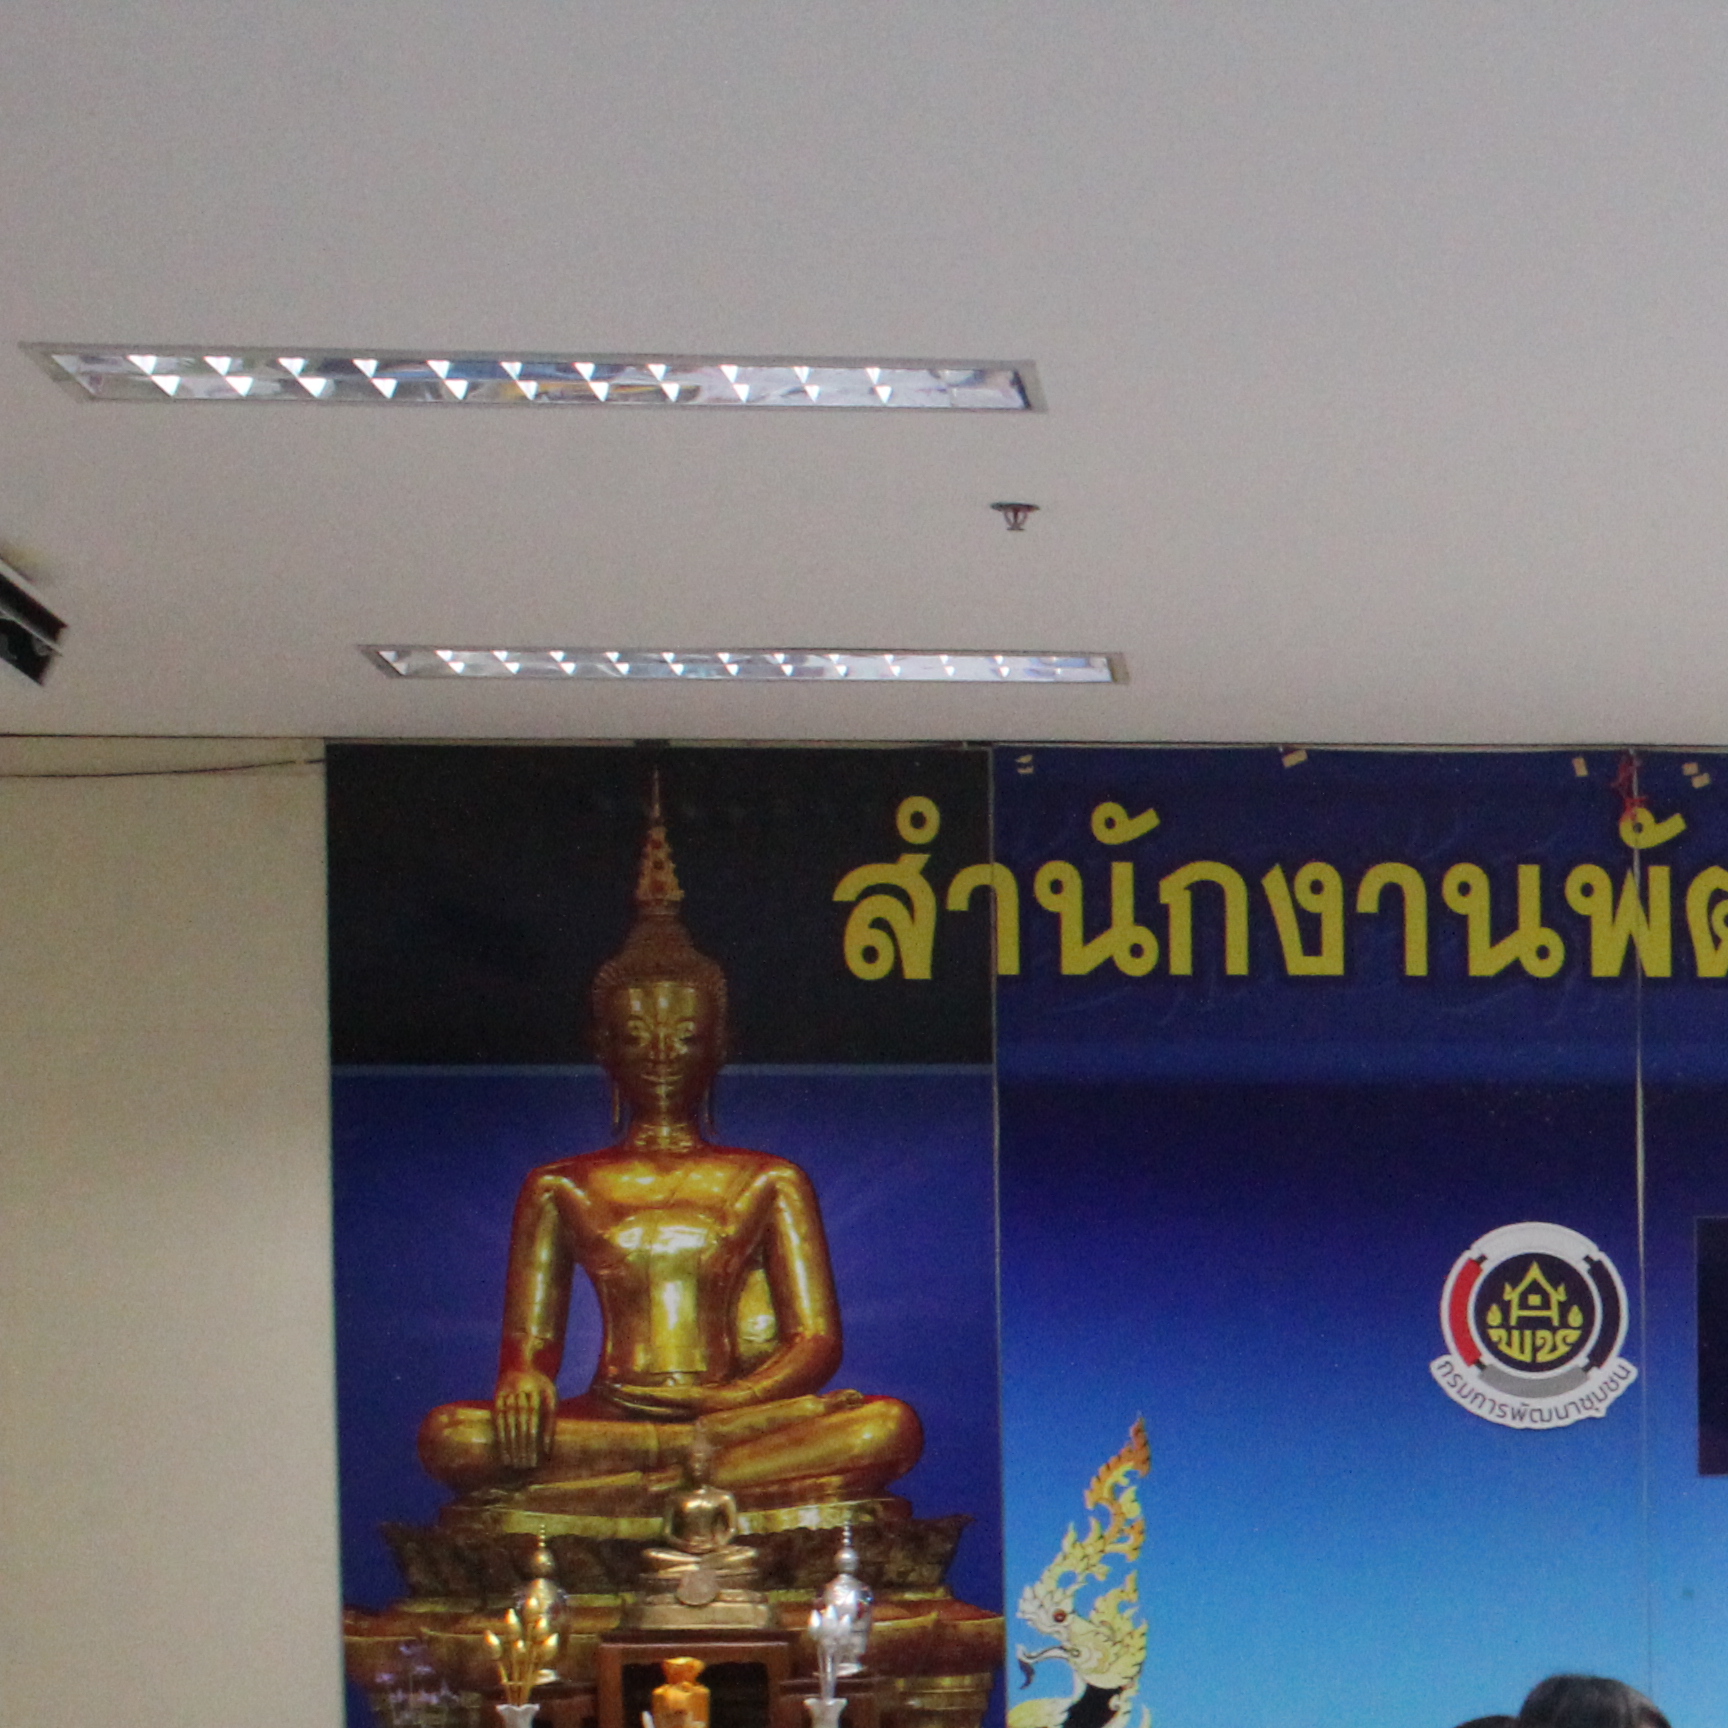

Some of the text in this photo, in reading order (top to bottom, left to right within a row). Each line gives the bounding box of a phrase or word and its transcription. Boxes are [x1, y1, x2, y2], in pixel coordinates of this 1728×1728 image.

[1436, 1359, 1632, 1424] กรมการพัฒนาชุมชน
